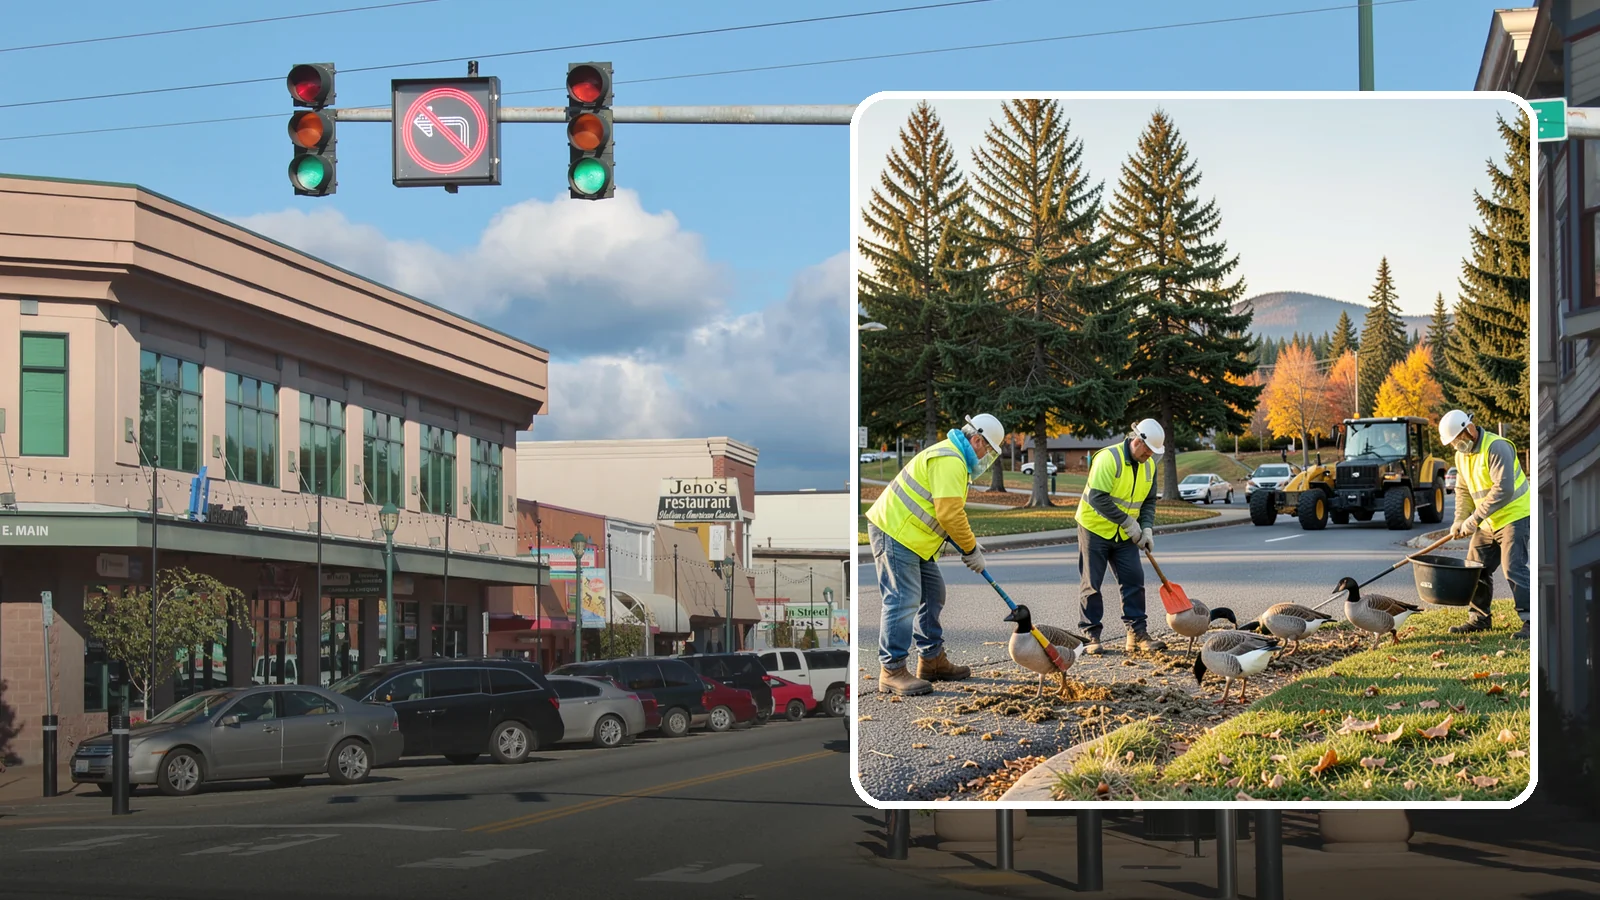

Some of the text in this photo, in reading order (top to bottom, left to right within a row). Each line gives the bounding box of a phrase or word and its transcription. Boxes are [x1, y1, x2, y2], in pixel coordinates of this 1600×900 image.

[670, 480, 727, 494] Jeno's
[665, 496, 731, 509] restaurant
[658, 510, 681, 519] Italian
[686, 510, 715, 519] American
[715, 509, 737, 519] Cuisine
[2, 525, 49, 536] E. MAIN
[797, 608, 828, 616] Street
